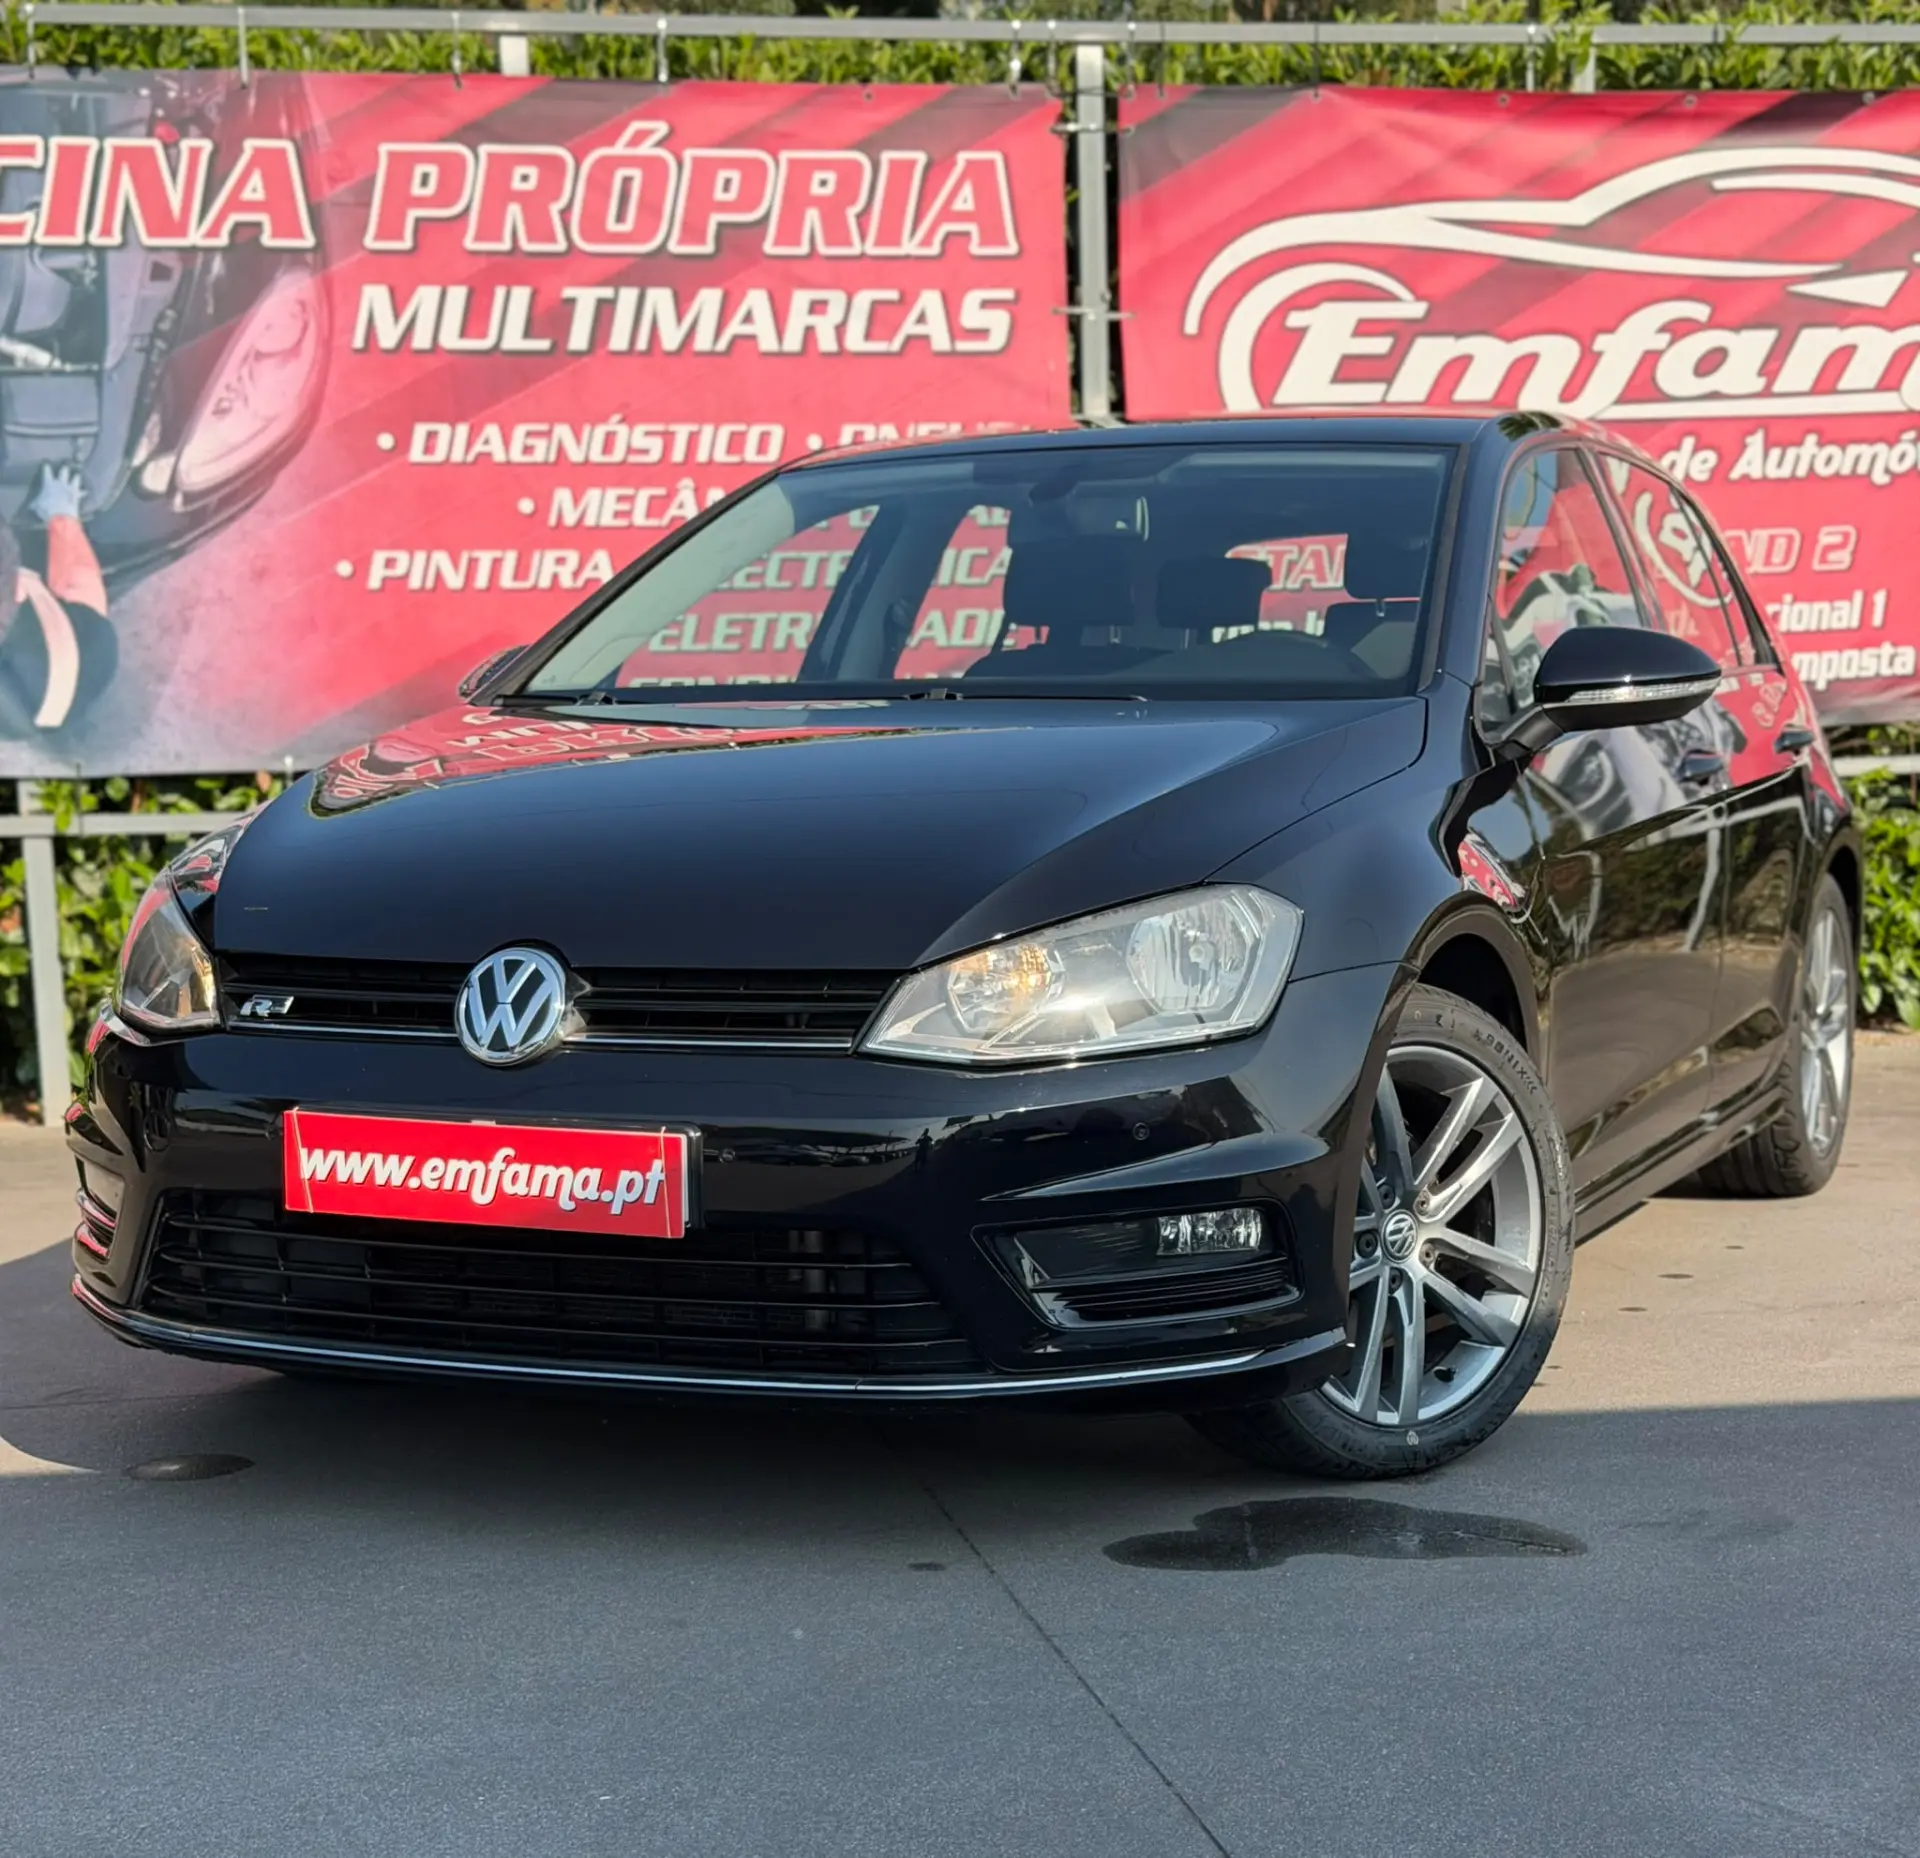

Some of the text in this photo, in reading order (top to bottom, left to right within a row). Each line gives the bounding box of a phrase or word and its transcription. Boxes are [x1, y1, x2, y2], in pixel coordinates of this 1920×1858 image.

[364, 120, 1019, 257] PRÓPRIA
[352, 284, 1017, 354] MULTIMARCAS
[408, 414, 785, 464] DIAGNÓSTICO
[1660, 435, 1718, 482] de
[547, 477, 726, 528] MECÂ
[366, 550, 616, 590] PINTURA
[1812, 525, 1857, 572] 2
[1872, 588, 1888, 629] 1
[300, 1147, 666, 1216] www.emfama.pt
